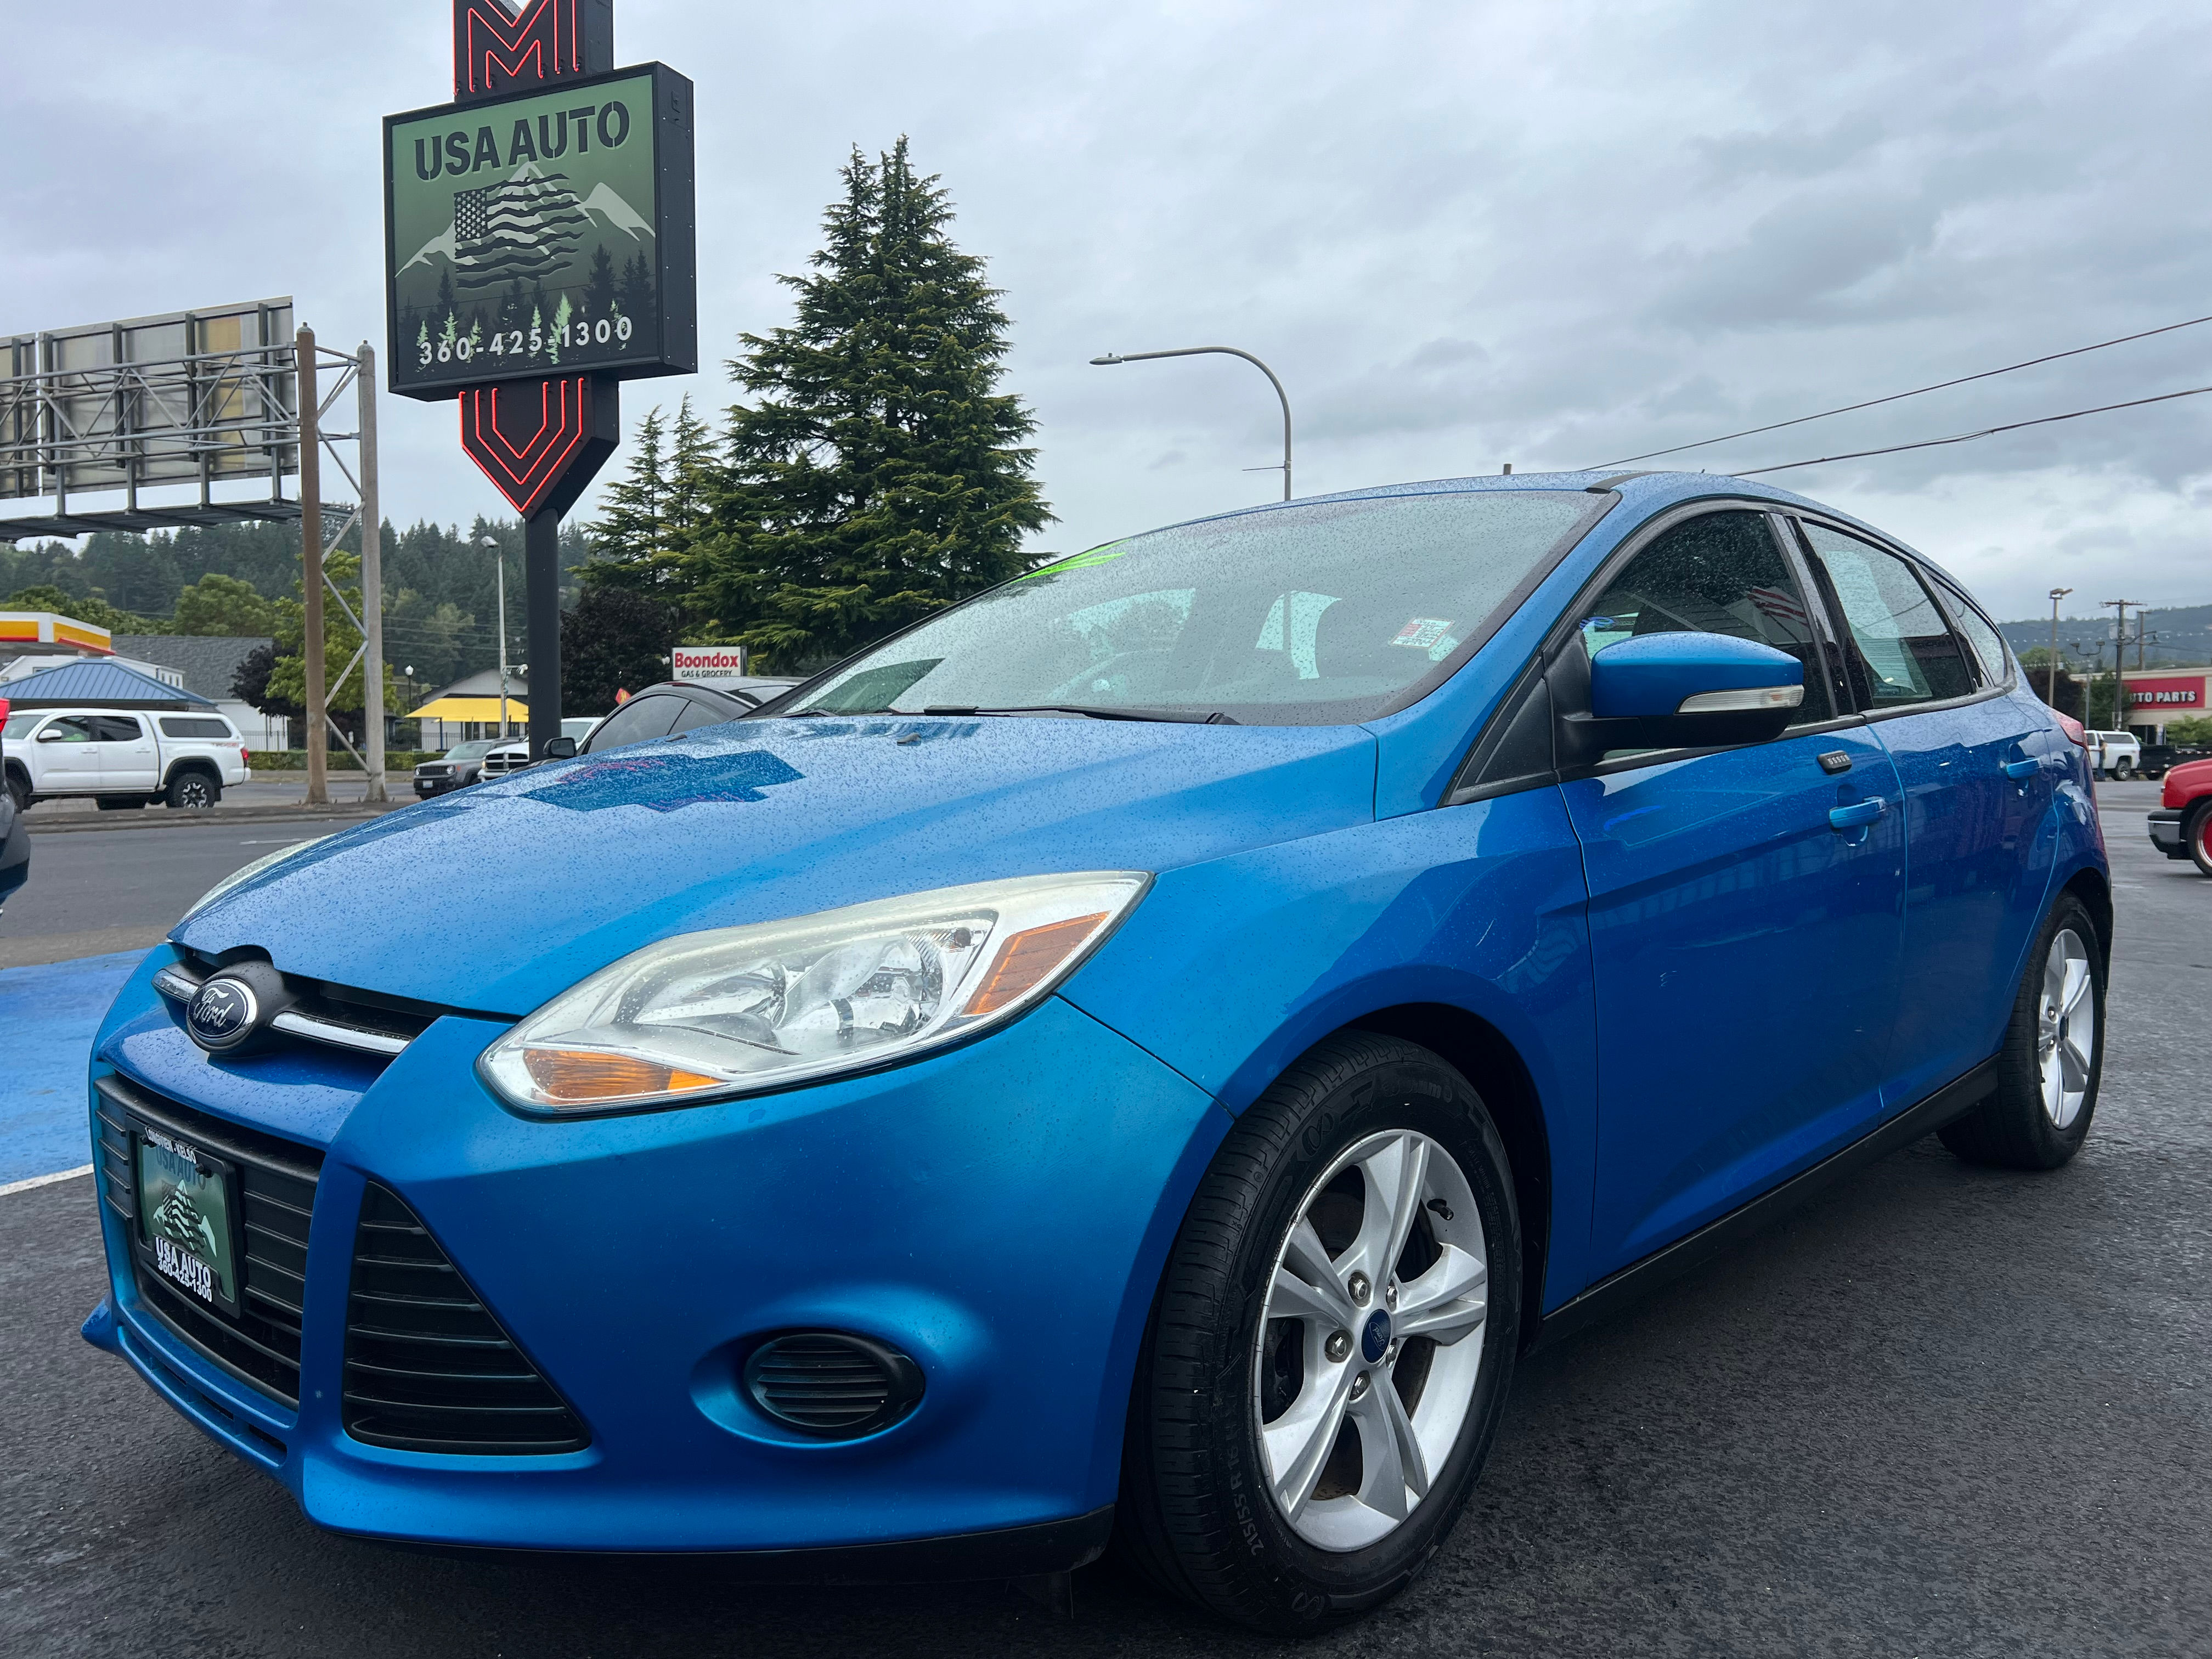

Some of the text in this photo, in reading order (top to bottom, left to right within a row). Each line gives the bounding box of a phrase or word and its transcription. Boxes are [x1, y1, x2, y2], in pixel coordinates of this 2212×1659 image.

[415, 101, 630, 181] USA AUTO
[419, 316, 633, 365] 360-425-1300
[675, 652, 739, 668] Boondox
[2129, 691, 2196, 703] UTO PARTS
[194, 988, 235, 1028] Ford
[156, 1237, 211, 1288] USA AUTO
[157, 1257, 212, 1302] 360-425-1300
[1373, 1326, 1386, 1347] Ford
